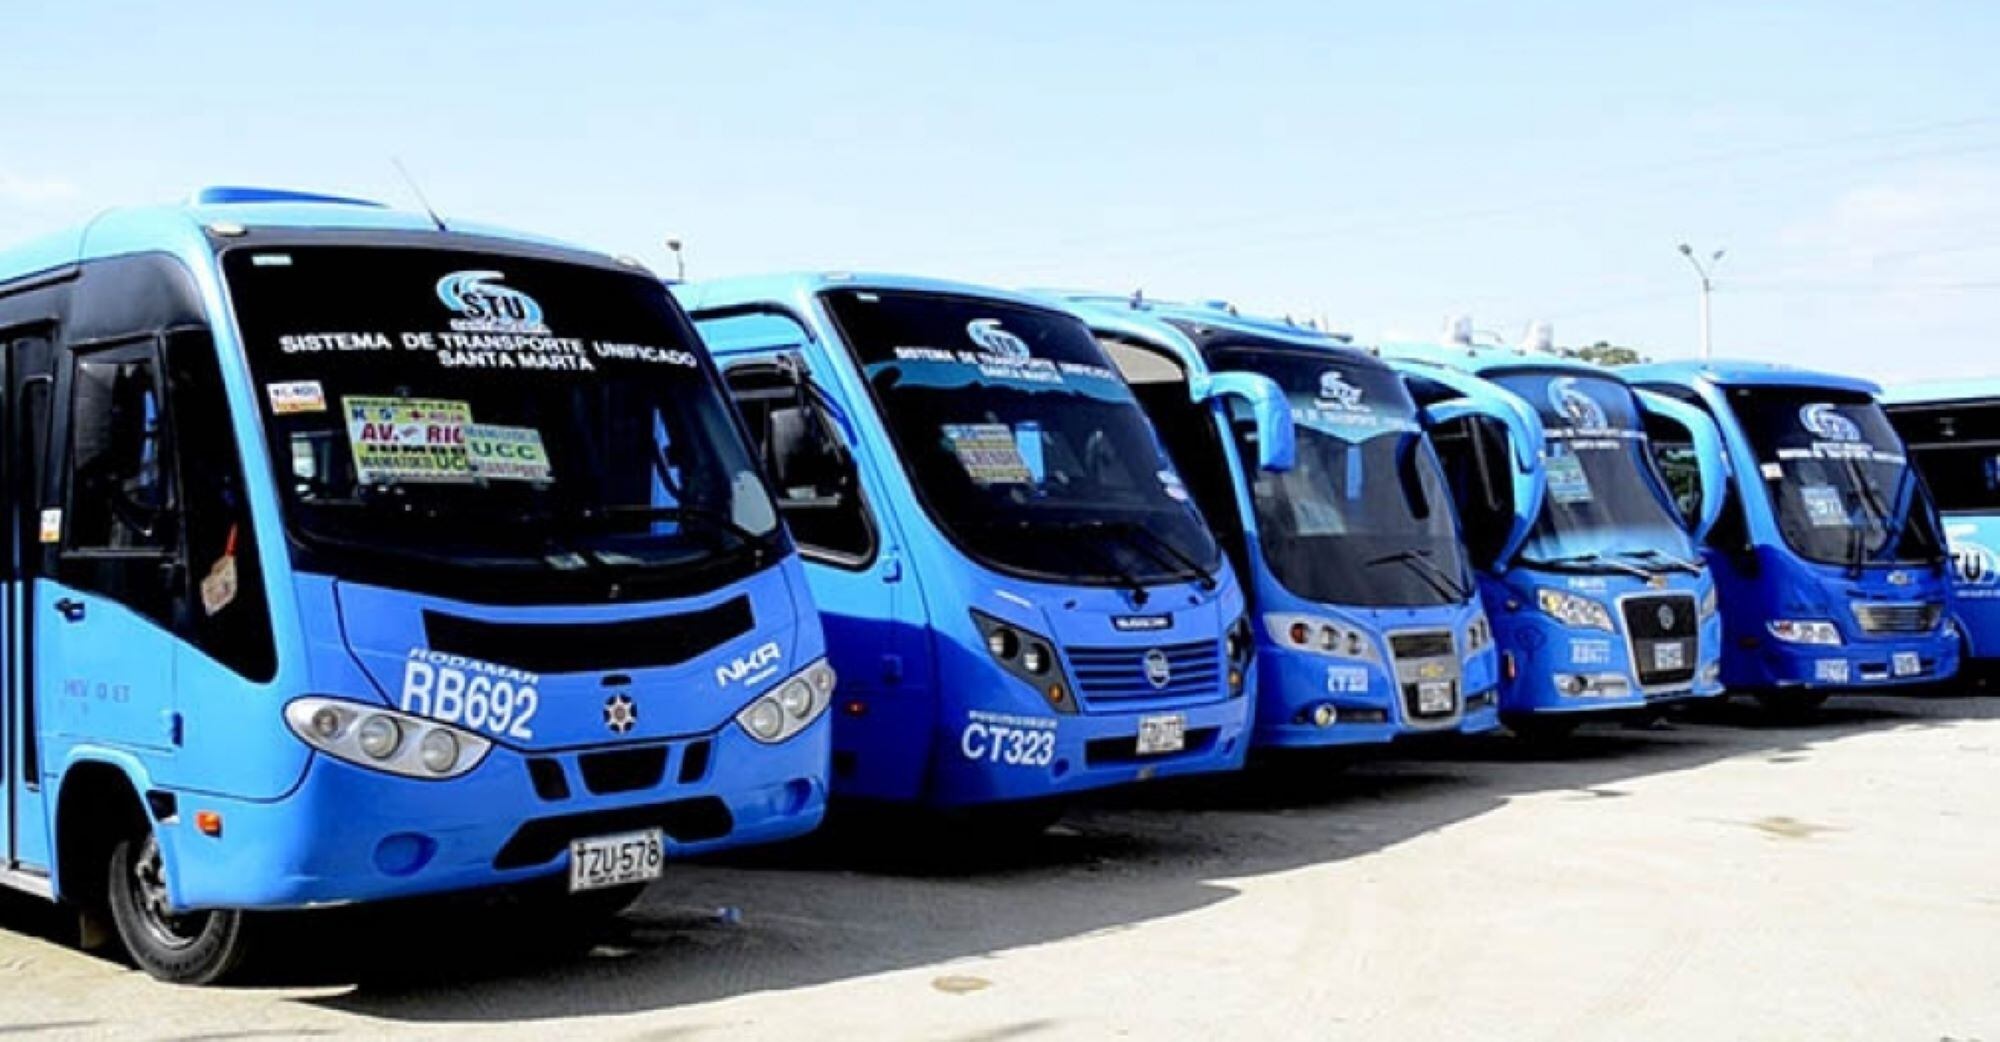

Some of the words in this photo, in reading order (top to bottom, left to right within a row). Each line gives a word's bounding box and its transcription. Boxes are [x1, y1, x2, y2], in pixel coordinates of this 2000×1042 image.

[279, 331, 393, 353] SISTEMA
[400, 331, 437, 351] DE
[438, 332, 585, 356] TRANSPORTE
[591, 341, 698, 368] UNIFICADO
[437, 350, 516, 368] SANTA
[518, 354, 596, 372] MARTA
[361, 422, 399, 442] AV.
[471, 441, 538, 460] UCC
[409, 647, 540, 685] RODAMAR
[715, 641, 782, 688] NKR
[401, 660, 539, 740] RB692
[961, 722, 1056, 766] CT323
[577, 838, 660, 878] TZU-578
